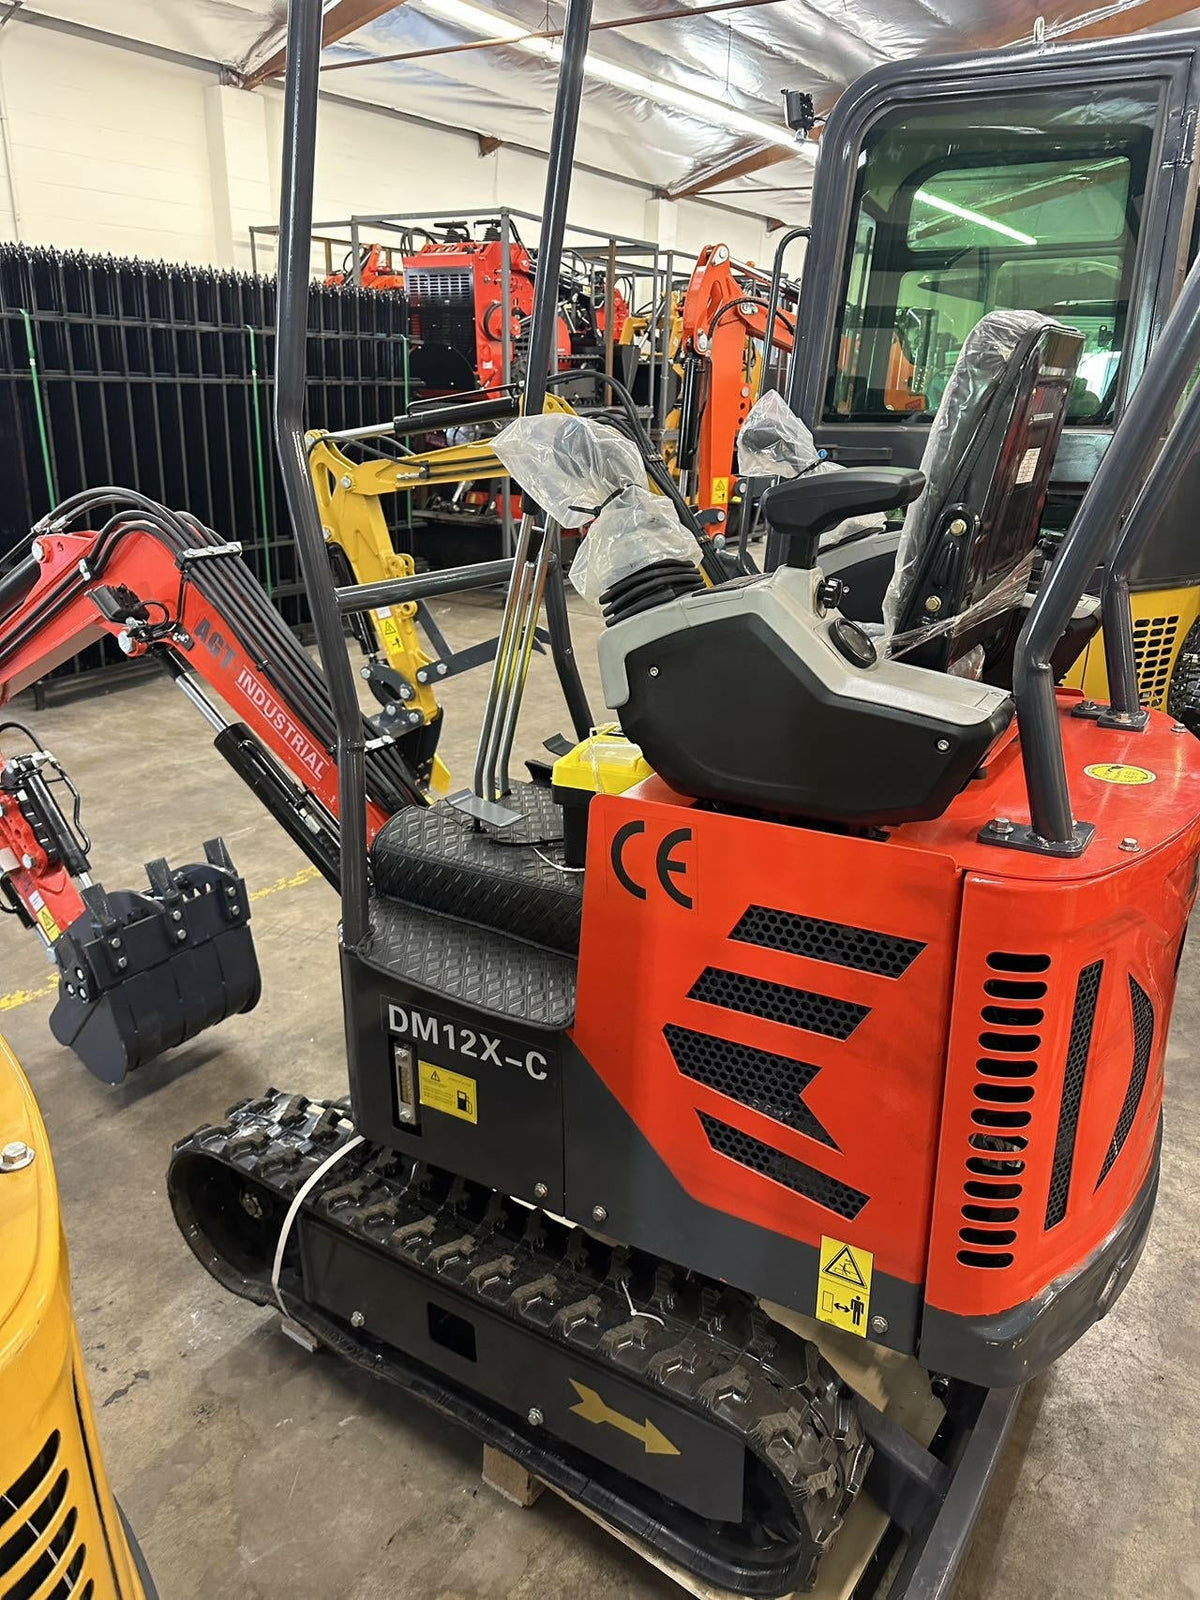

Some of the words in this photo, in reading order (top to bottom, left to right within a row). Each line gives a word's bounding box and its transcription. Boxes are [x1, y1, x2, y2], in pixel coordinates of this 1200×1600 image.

[193, 617, 237, 670] AGT
[237, 669, 324, 780] INDUSTRIAL
[611, 820, 693, 910] CE
[388, 1003, 548, 1081] DM12X-C
